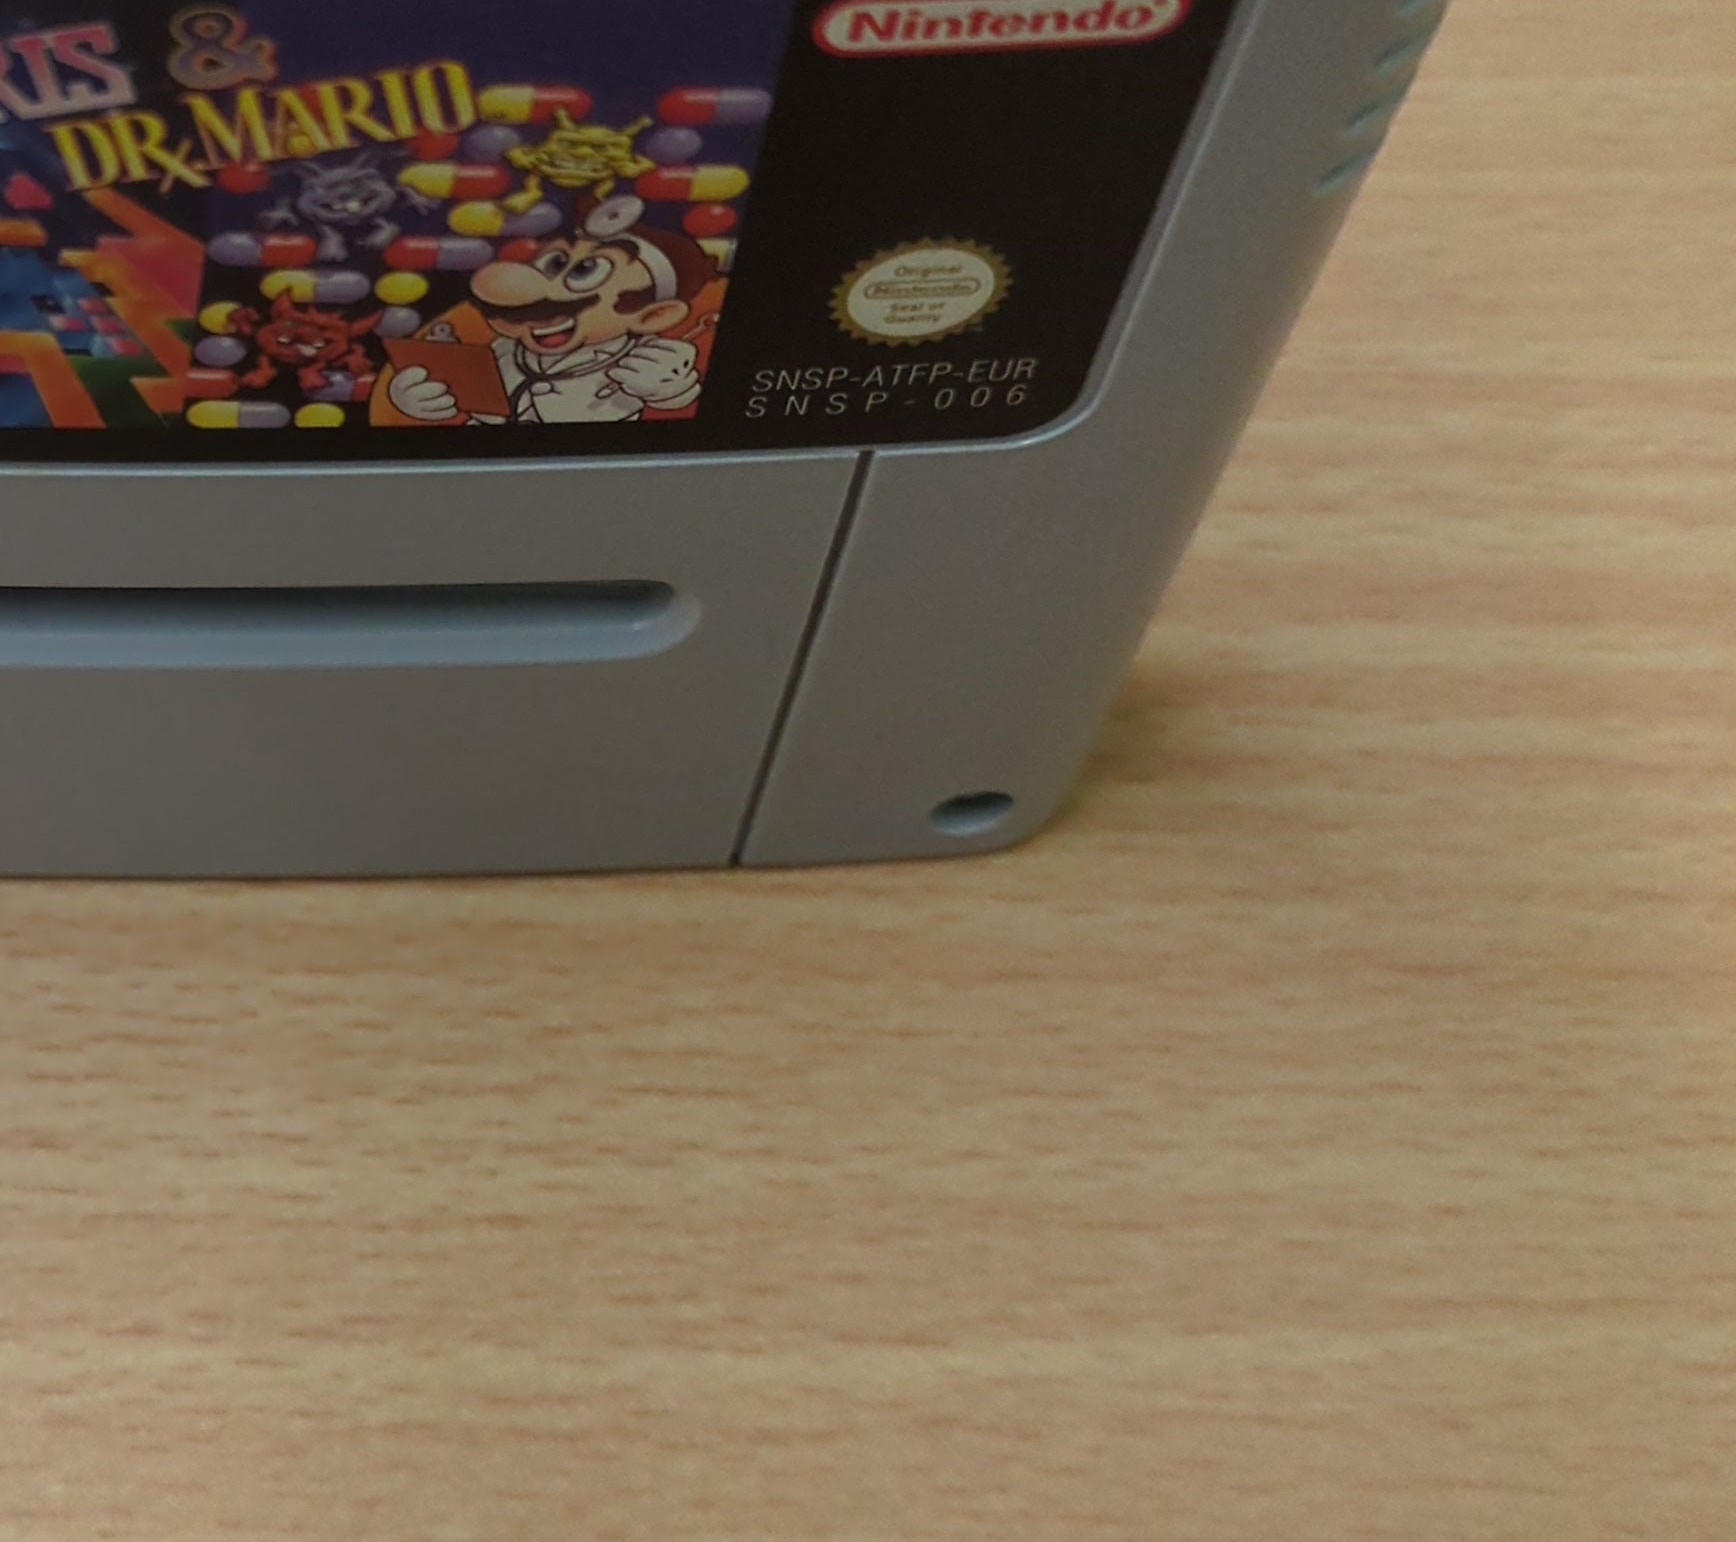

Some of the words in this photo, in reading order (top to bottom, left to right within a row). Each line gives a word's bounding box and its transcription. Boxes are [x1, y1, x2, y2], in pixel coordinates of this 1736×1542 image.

[168, 4, 279, 91] &
[177, 59, 481, 168] MARIO
[751, 358, 1040, 392] SNSP-ATFP-EUR
